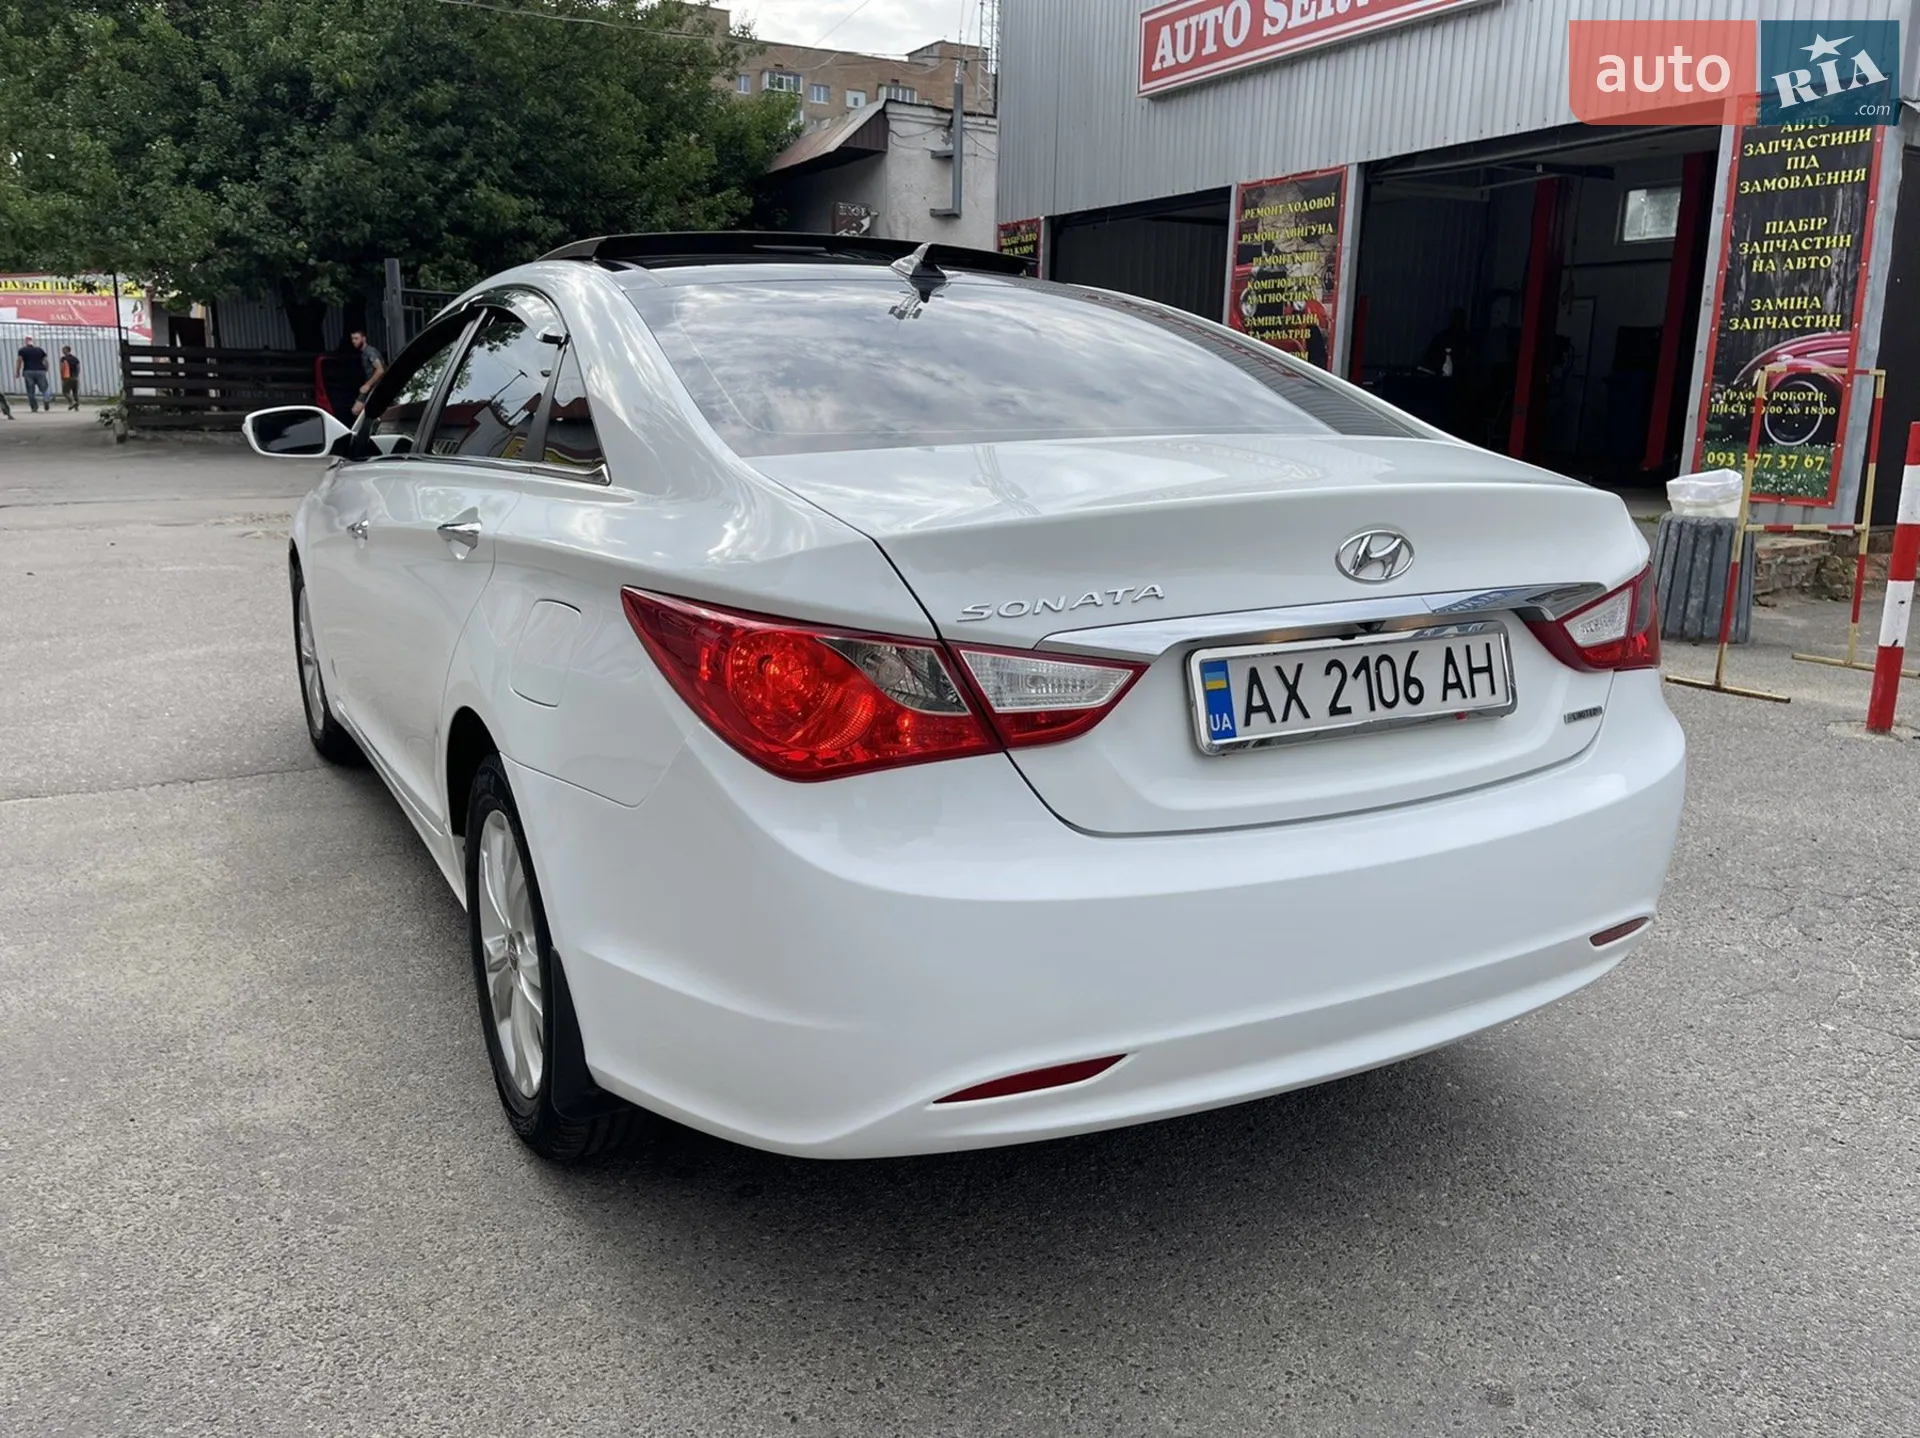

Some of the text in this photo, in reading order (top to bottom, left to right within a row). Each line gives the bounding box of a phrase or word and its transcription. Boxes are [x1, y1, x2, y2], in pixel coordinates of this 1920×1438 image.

[1152, 0, 1251, 71] AUTO
[1743, 128, 1872, 157] ЗАПЧАСТИНИ
[1786, 154, 1820, 170] ПІД
[1739, 167, 1867, 194] ЗАМОВЛЕННЯ
[1244, 192, 1336, 219] РЕМОНТ ХОДОВОЇ
[1242, 223, 1334, 243] РЕМОНТ ДВИГУНА
[1764, 216, 1828, 235] ПІДБІР
[1738, 234, 1852, 255] ЗАПЧАСТИН
[1751, 255, 1832, 273] НА АВТО
[1750, 296, 1822, 312] ЗАМІНА
[1244, 314, 1282, 328] ЗАМІНА
[1728, 314, 1842, 331] ЗАПЧАСТИН
[1722, 390, 1828, 402] ГРАФК РОБОТИ:
[1707, 451, 1736, 467] 093
[1778, 454, 1798, 471] 37
[1803, 454, 1825, 471] 67
[956, 584, 1165, 622] SONATA
[1244, 642, 1497, 728] AX 2106 AH
[1209, 712, 1233, 732] UA
